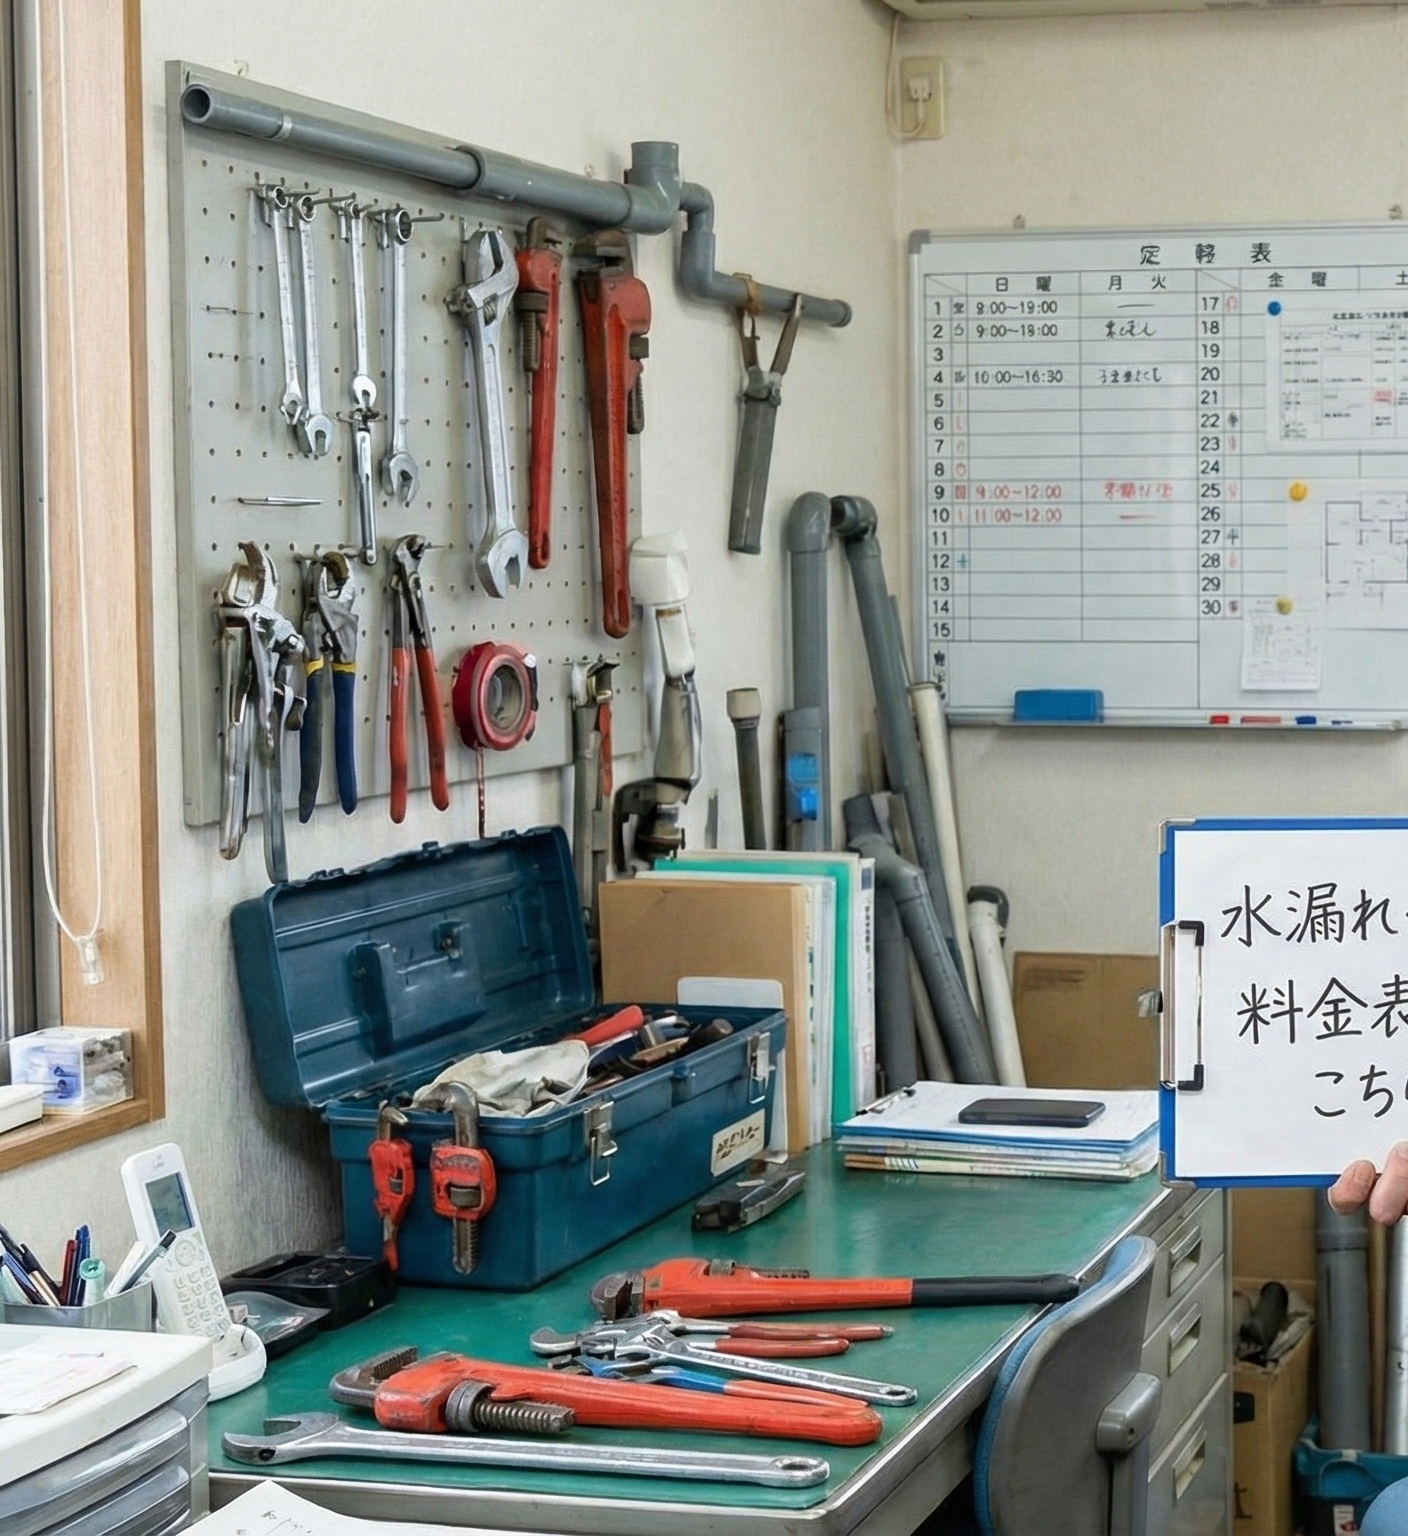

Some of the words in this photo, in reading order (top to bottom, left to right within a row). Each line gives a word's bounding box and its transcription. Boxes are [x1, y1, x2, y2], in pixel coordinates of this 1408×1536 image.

[934, 301, 941, 316] 1
[1201, 296, 1220, 311] 17
[932, 323, 944, 339] 2
[1201, 320, 1220, 335] 18
[933, 347, 944, 362] 3
[1201, 342, 1221, 359] 19
[933, 370, 944, 384] 4
[1200, 366, 1221, 382] 20
[934, 393, 944, 408] 5
[1200, 389, 1218, 405] 21
[933, 416, 945, 431] 6
[1200, 413, 1220, 428] 22
[934, 438, 945, 454] 7
[1200, 436, 1220, 452] 23
[934, 461, 945, 477] 8
[1200, 459, 1220, 475] 24
[934, 484, 945, 500] 9
[1200, 483, 1221, 498] 25
[932, 507, 950, 523] 10
[1200, 506, 1221, 522] 26
[932, 530, 948, 546] 11
[1201, 529, 1221, 545] 27
[932, 553, 950, 569] 12
[1201, 552, 1221, 569] 28
[932, 576, 950, 592] 13
[1201, 576, 1221, 592] 29
[932, 599, 950, 614] 14
[1201, 599, 1222, 616] 30
